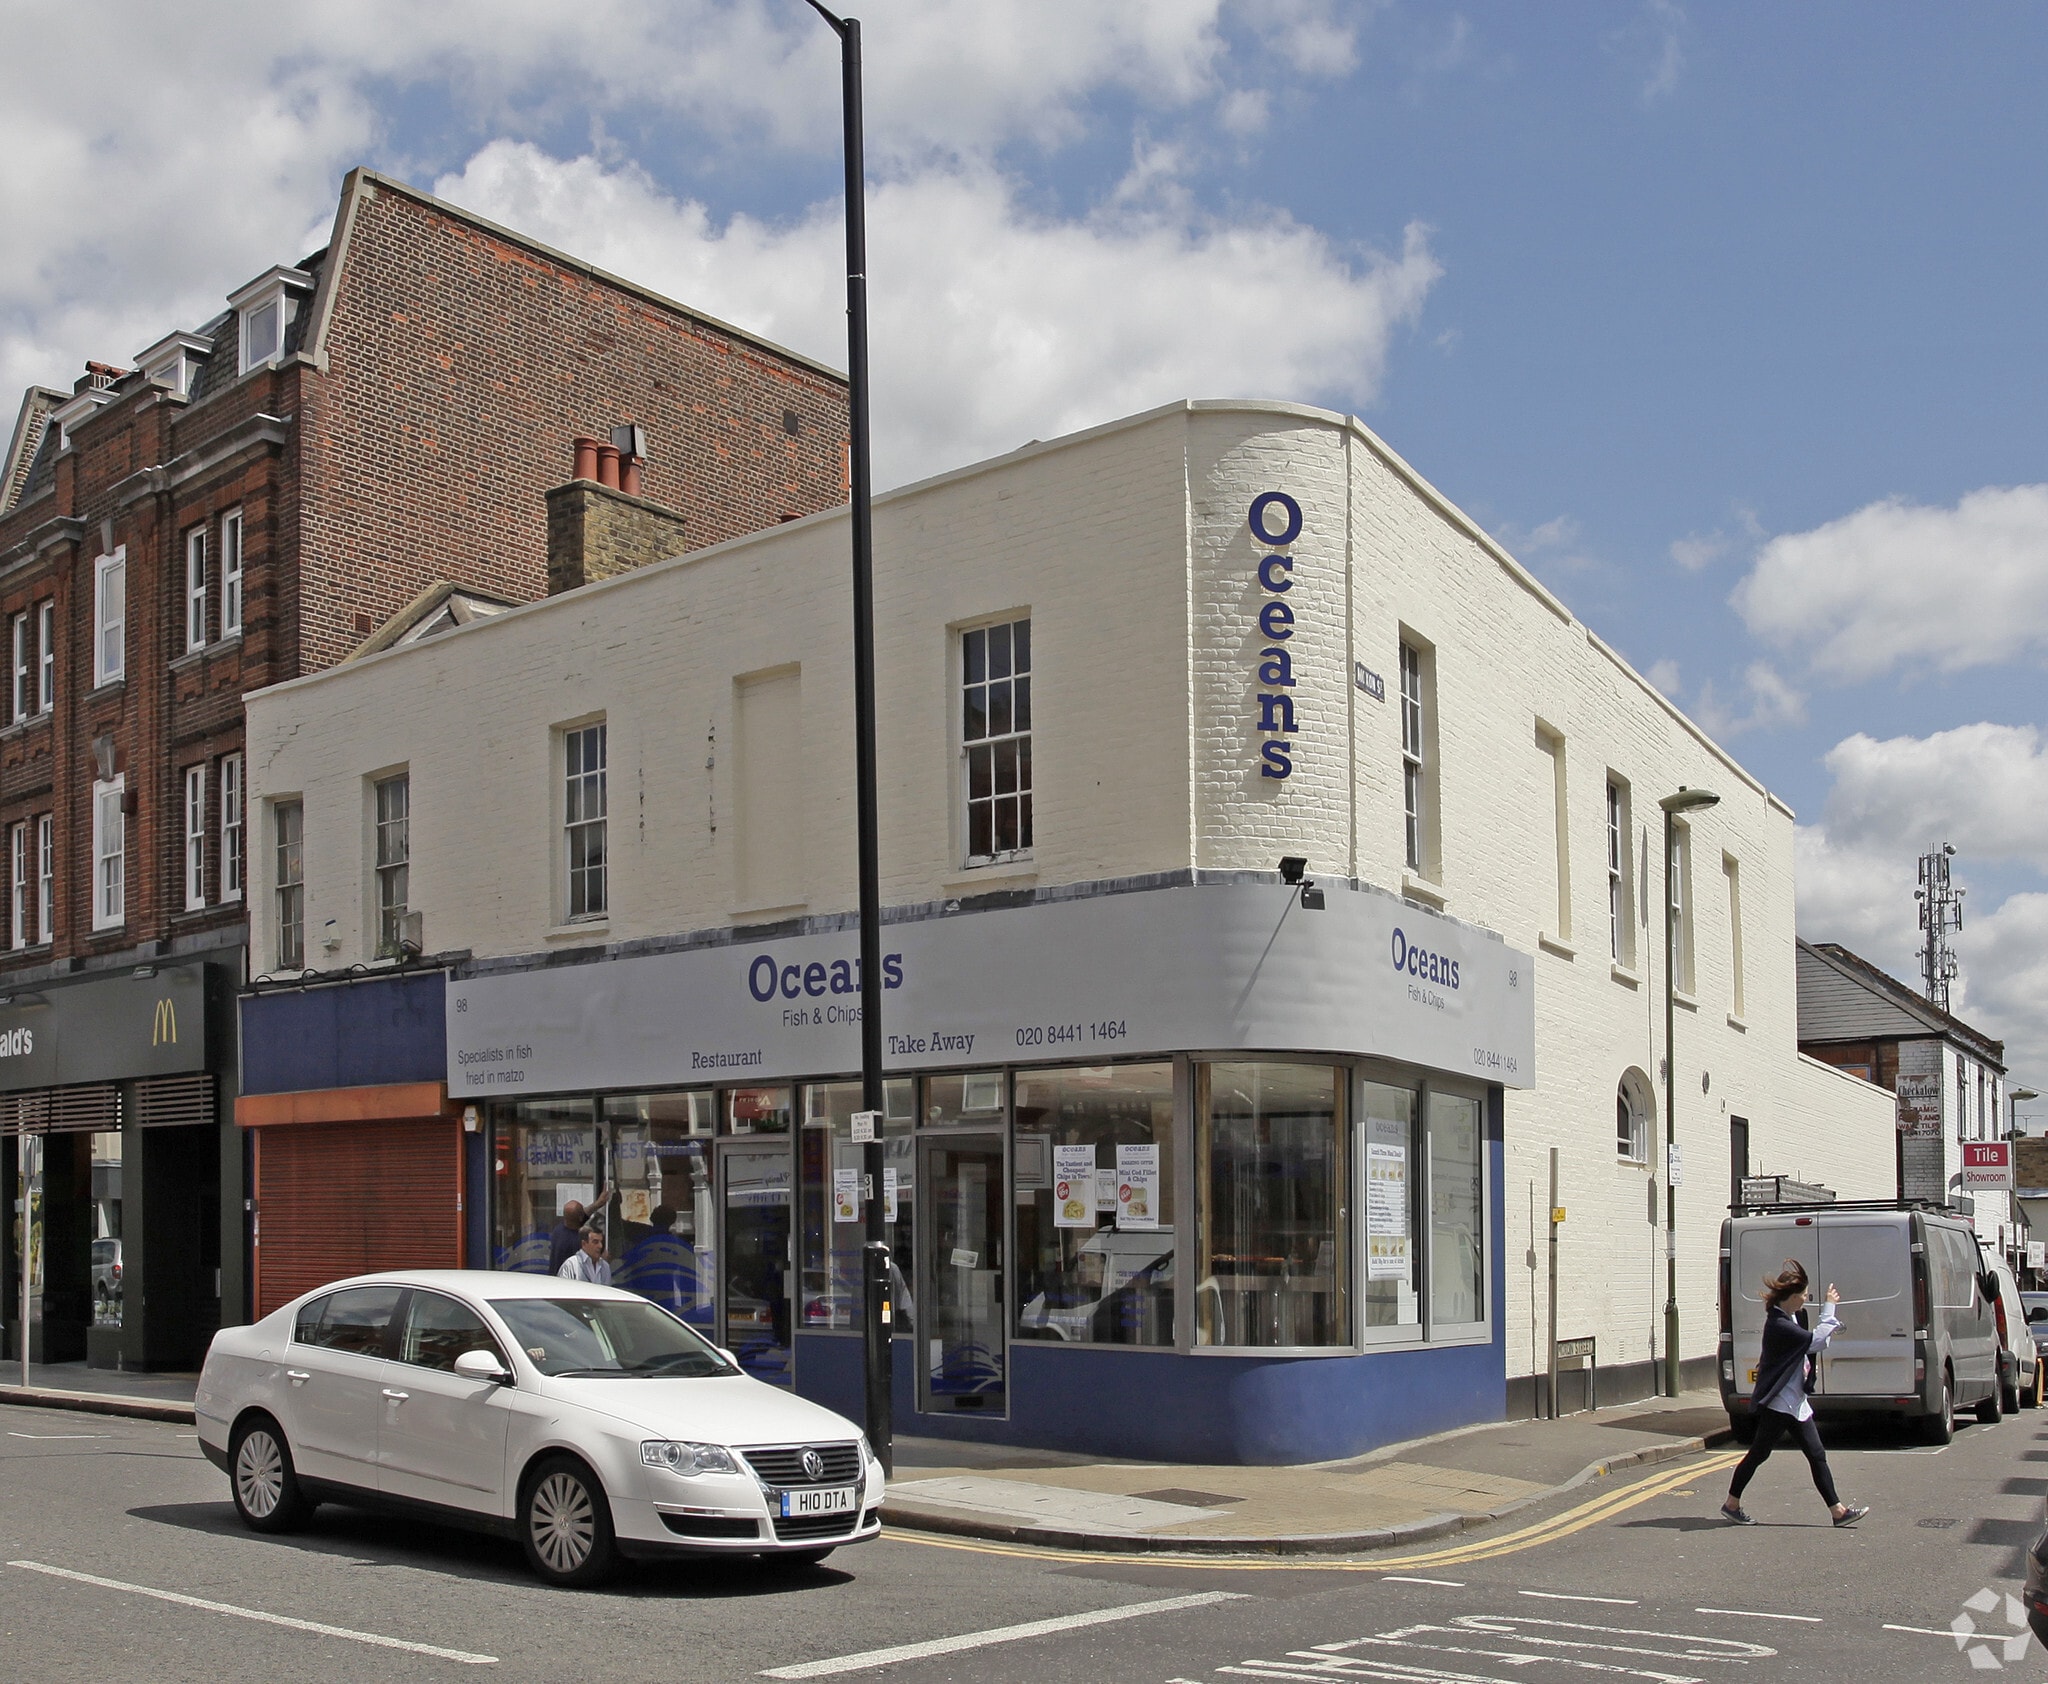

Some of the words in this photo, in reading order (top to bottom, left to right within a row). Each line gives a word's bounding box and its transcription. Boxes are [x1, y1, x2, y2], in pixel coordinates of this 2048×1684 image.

[1248, 491, 1303, 779] Oceans
[1391, 927, 1460, 990] Oceans
[1508, 970, 1518, 987] 98
[456, 998, 468, 1013] 98
[1408, 984, 1421, 1002] Fish
[1422, 989, 1427, 1003] &
[1428, 990, 1445, 1010] Chips
[783, 1010, 808, 1027] Fish
[813, 1010, 822, 1025] &
[827, 1005, 863, 1026] Chips
[0, 1028, 33, 1057] ald's
[888, 1034, 926, 1054] Take
[930, 1032, 975, 1054] Away
[1016, 1027, 1043, 1046] 020
[1048, 1024, 1083, 1044] 8441
[1090, 1020, 1127, 1041] 1464
[458, 1048, 504, 1067] Specialists
[506, 1047, 514, 1060] in
[516, 1044, 533, 1059] fish
[691, 1049, 762, 1069] Restaurant
[466, 1070, 485, 1086] fried
[487, 1070, 495, 1083] in
[497, 1068, 525, 1083] matzo
[1973, 1147, 1999, 1162] Tile
[1966, 1171, 2007, 1182] Showroom
[824, 1486, 847, 1510] DTA
